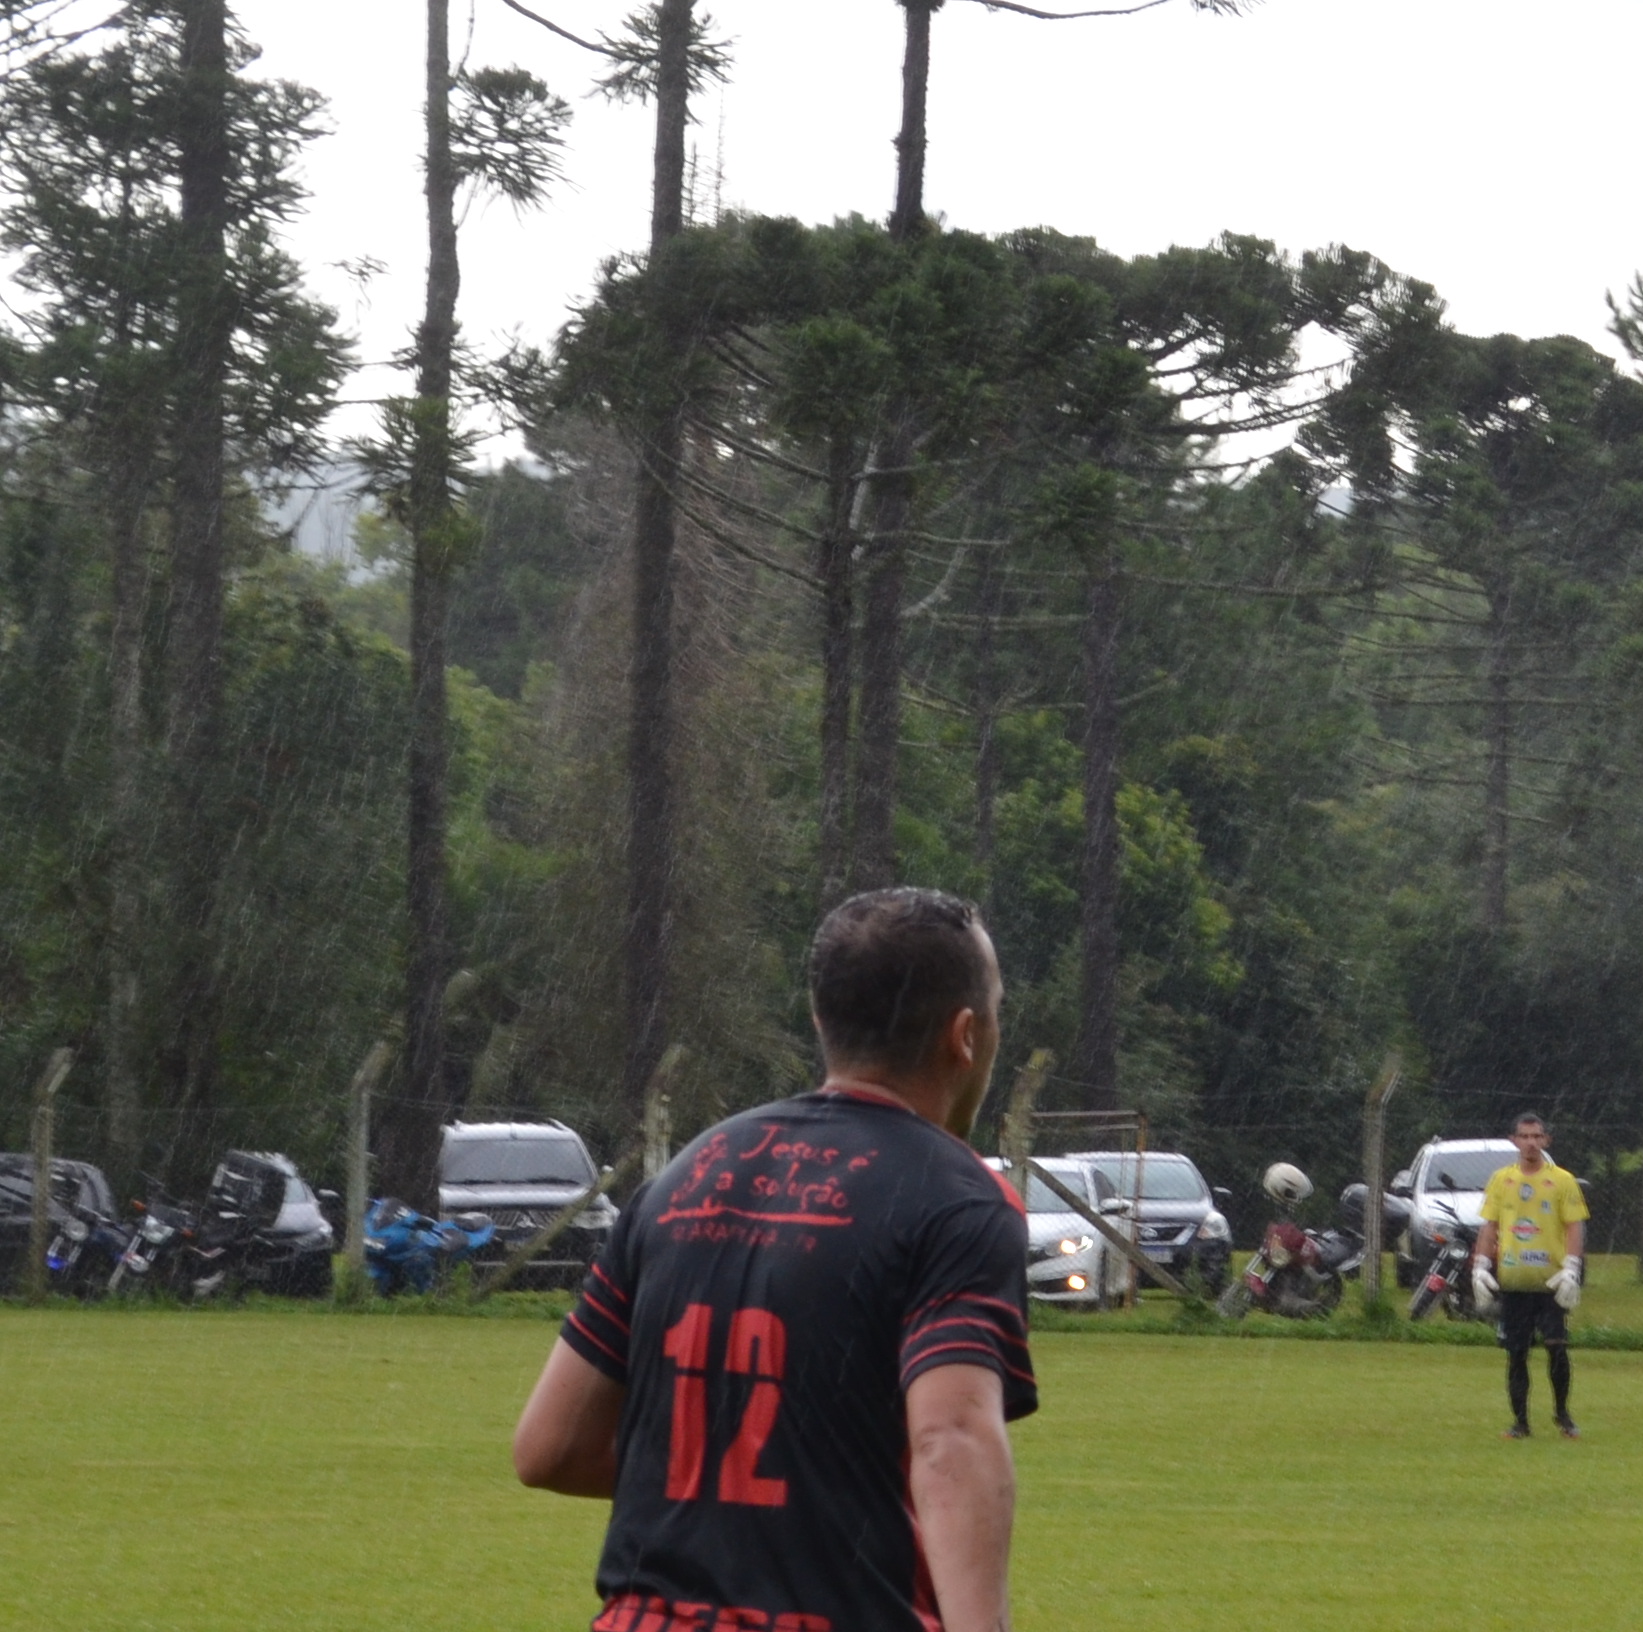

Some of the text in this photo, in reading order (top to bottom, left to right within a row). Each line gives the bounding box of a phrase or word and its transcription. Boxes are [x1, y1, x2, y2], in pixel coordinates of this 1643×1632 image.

[739, 1124, 839, 1165] Jesus
[715, 1171, 735, 1191] a
[664, 1302, 788, 1506] 12
